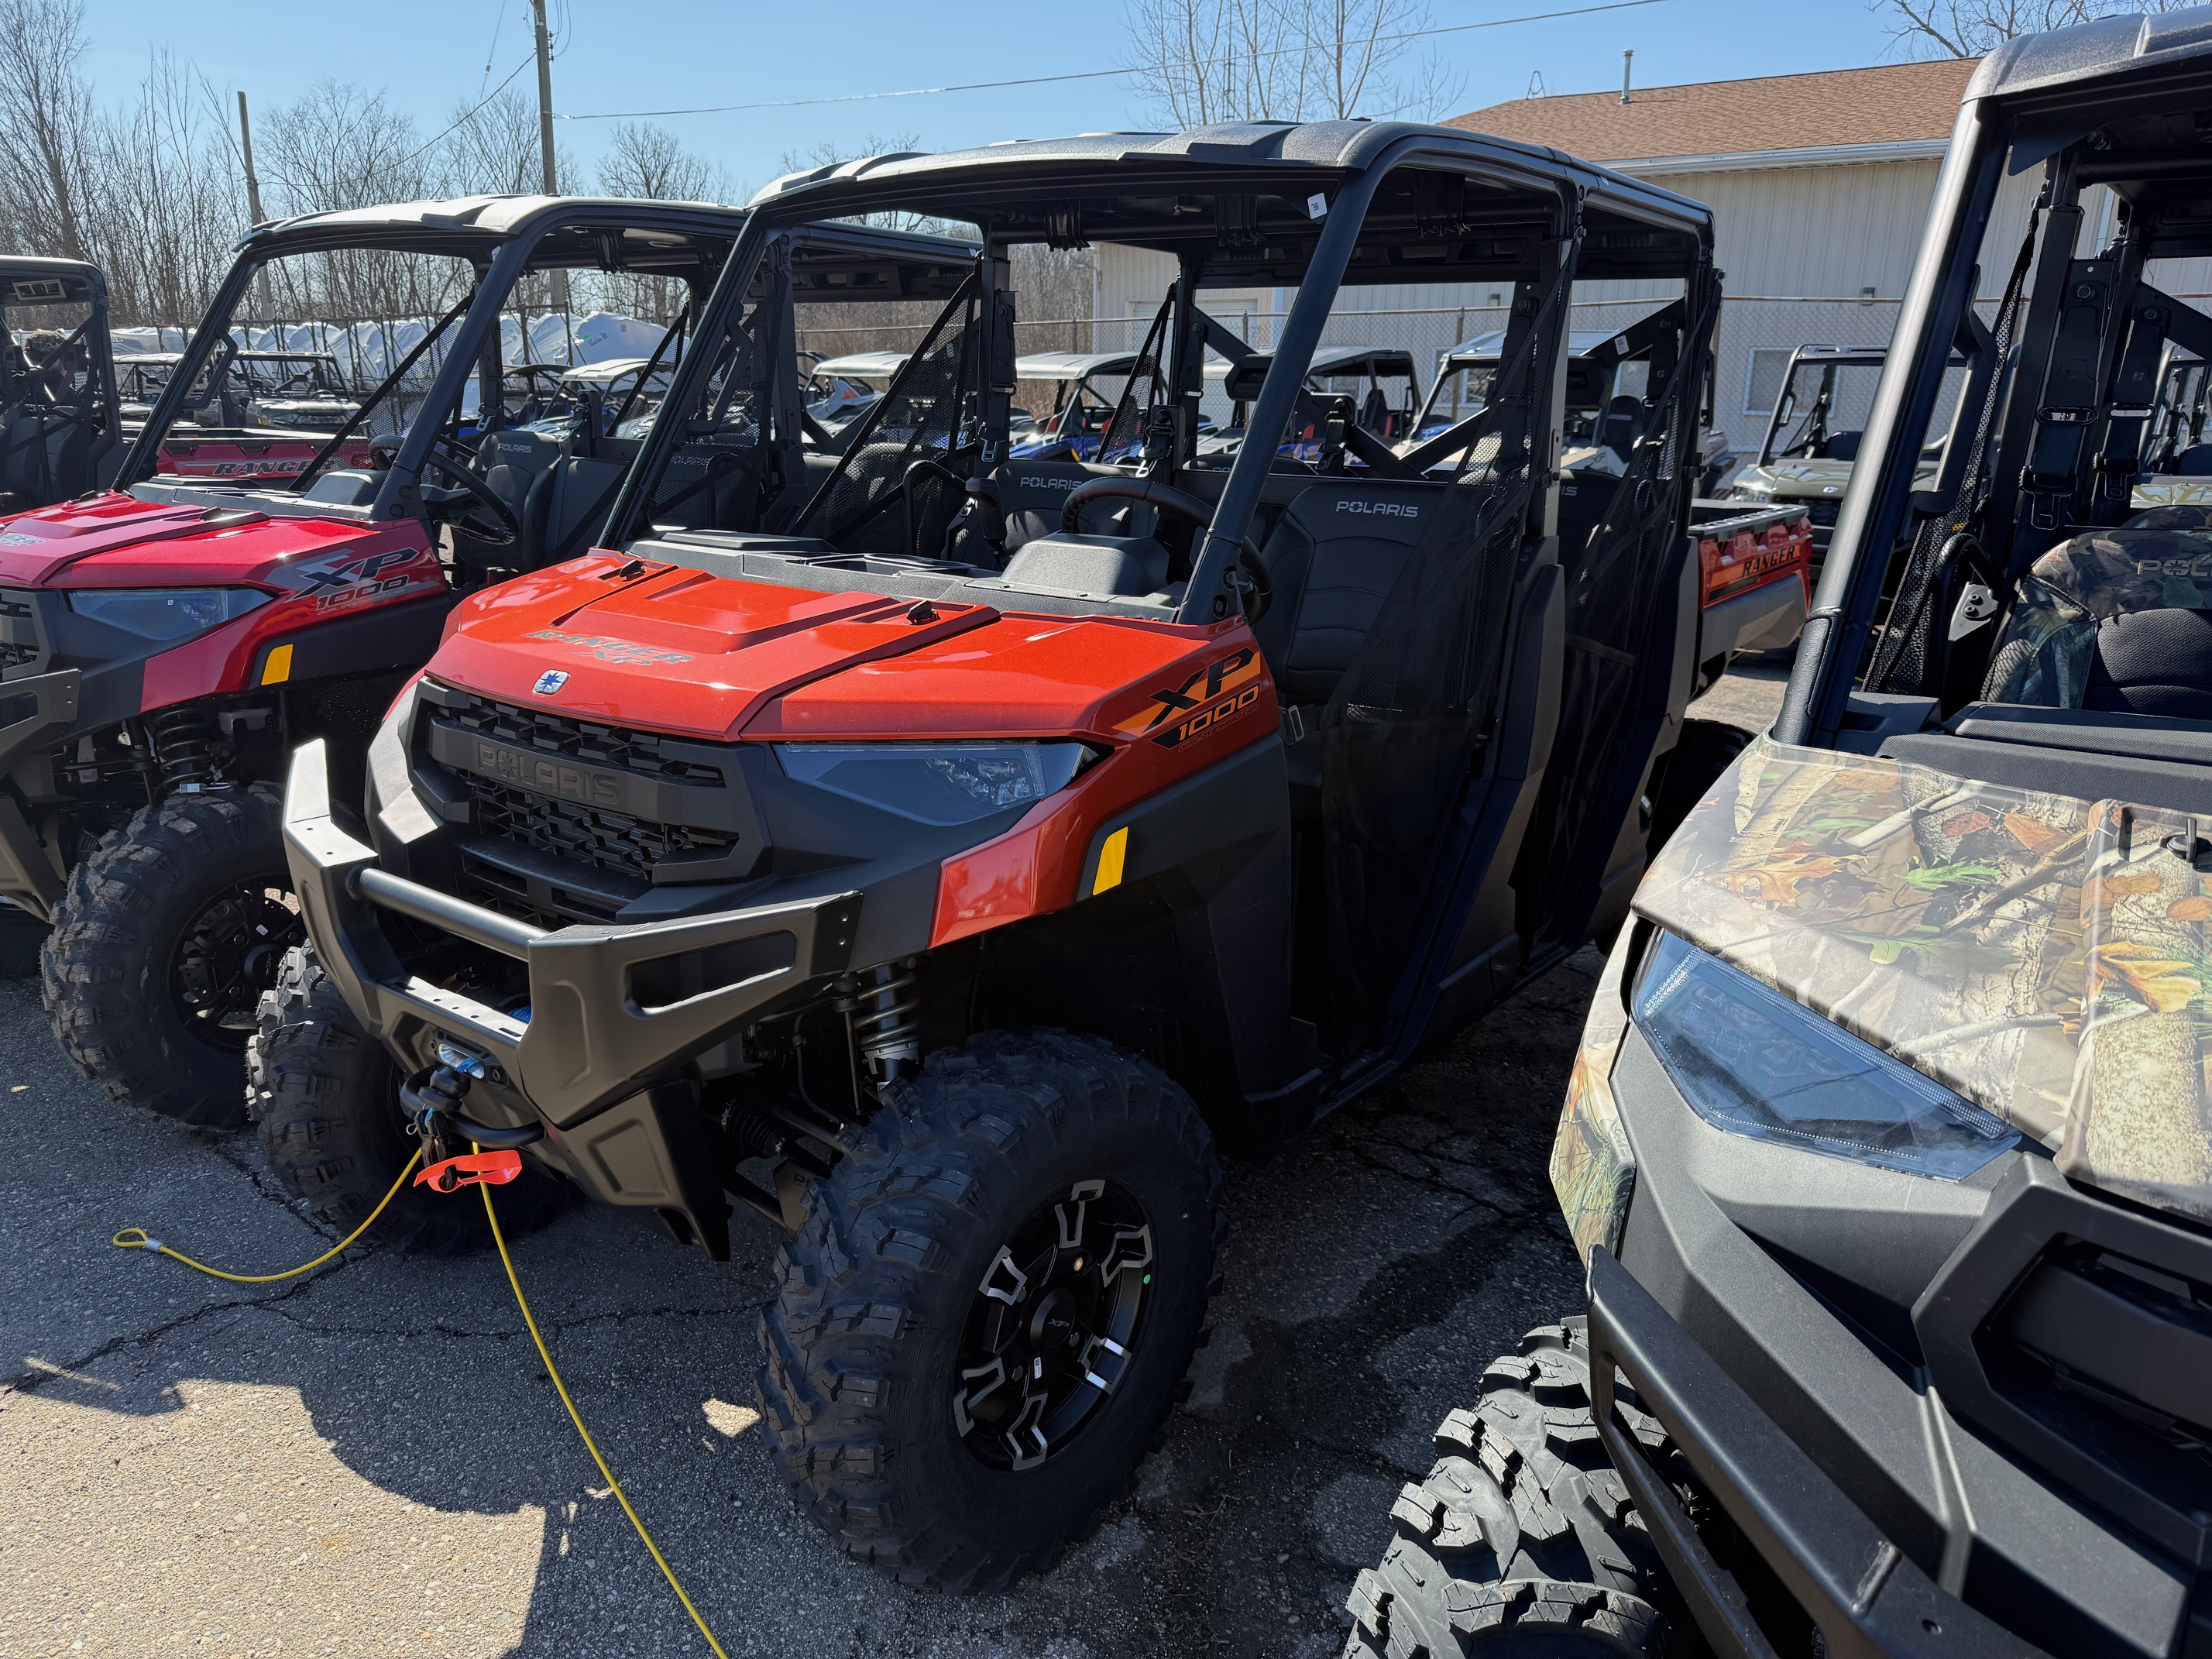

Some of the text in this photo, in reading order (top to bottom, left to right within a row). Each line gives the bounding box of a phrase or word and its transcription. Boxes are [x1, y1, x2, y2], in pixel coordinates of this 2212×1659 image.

[497, 443, 532, 453] POLARIS
[1020, 477, 1083, 490] POLARIS
[1336, 501, 1419, 517] POLARIS
[283, 547, 421, 603] XP
[1741, 545, 1796, 578] RANGER
[315, 574, 410, 612] 1000
[317, 607, 339, 616] DUAL
[522, 630, 695, 664] RANGER
[567, 650, 652, 665] XP
[1142, 647, 1256, 733] XP
[1179, 685, 1259, 741] 1000
[478, 742, 620, 805] POLARIS
[1047, 1318, 1070, 1327] XP
